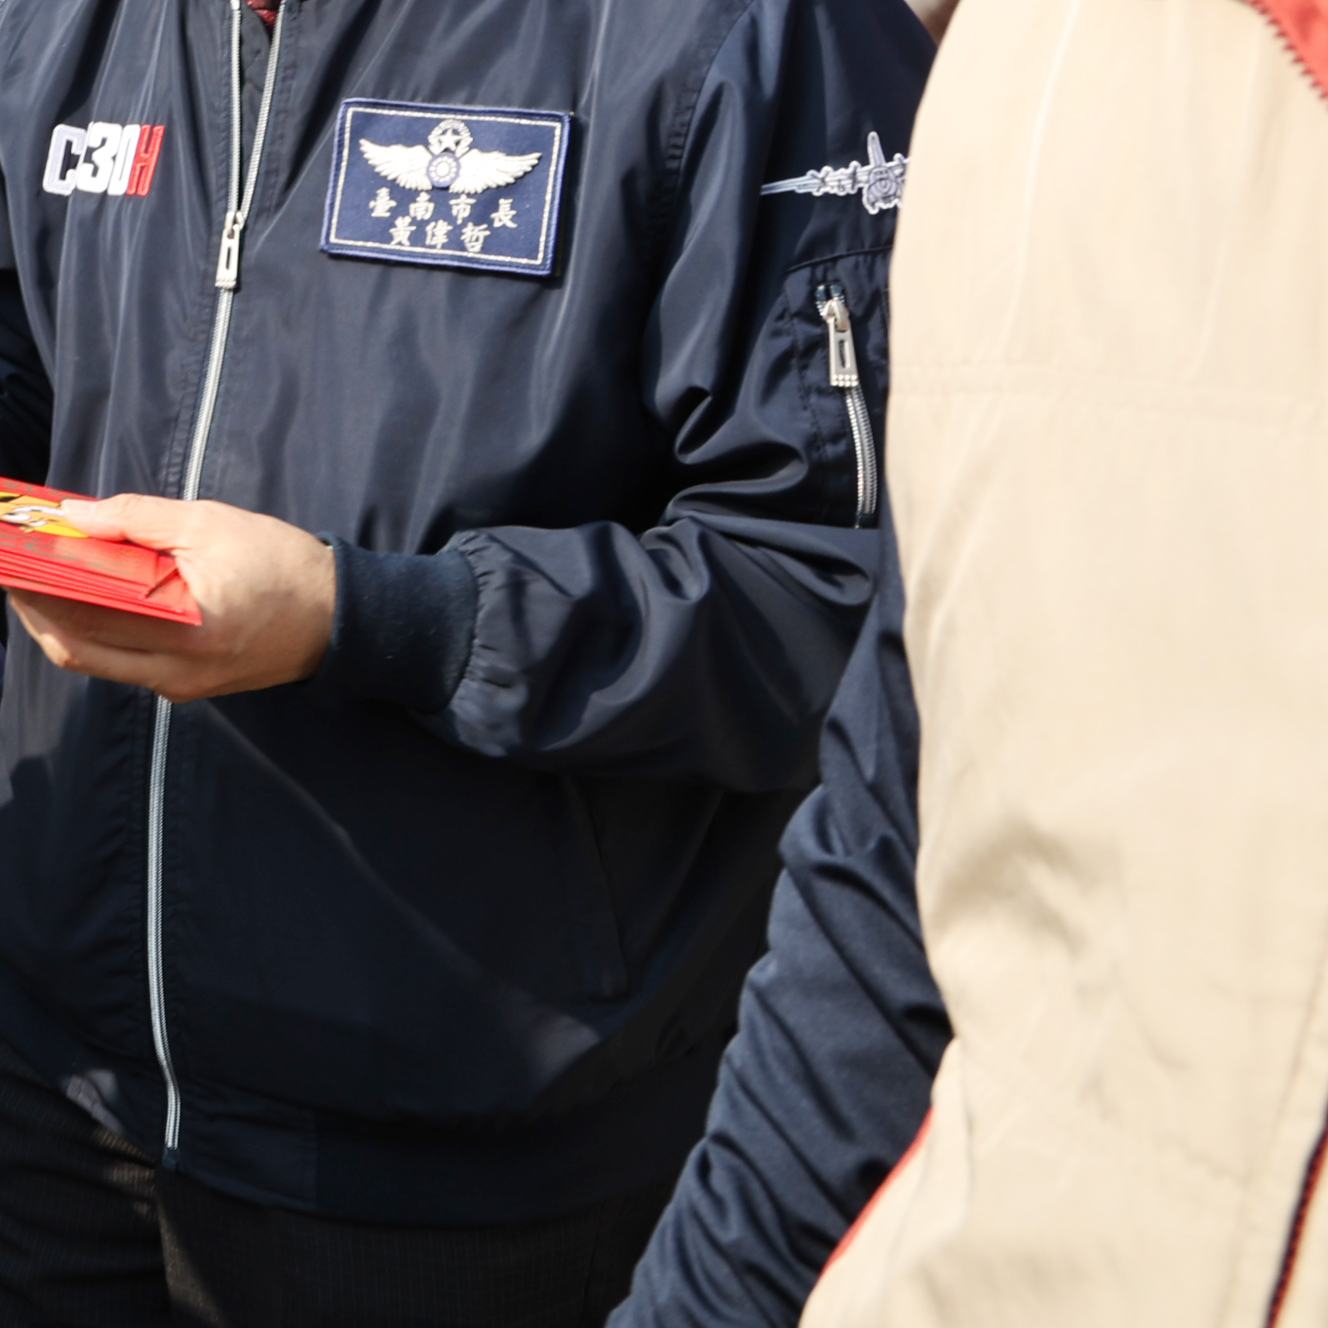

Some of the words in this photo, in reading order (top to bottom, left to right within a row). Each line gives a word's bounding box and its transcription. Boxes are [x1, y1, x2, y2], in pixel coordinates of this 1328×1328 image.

[368, 187, 519, 229] 臺南市長
[389, 216, 492, 254] 黃偉哲
